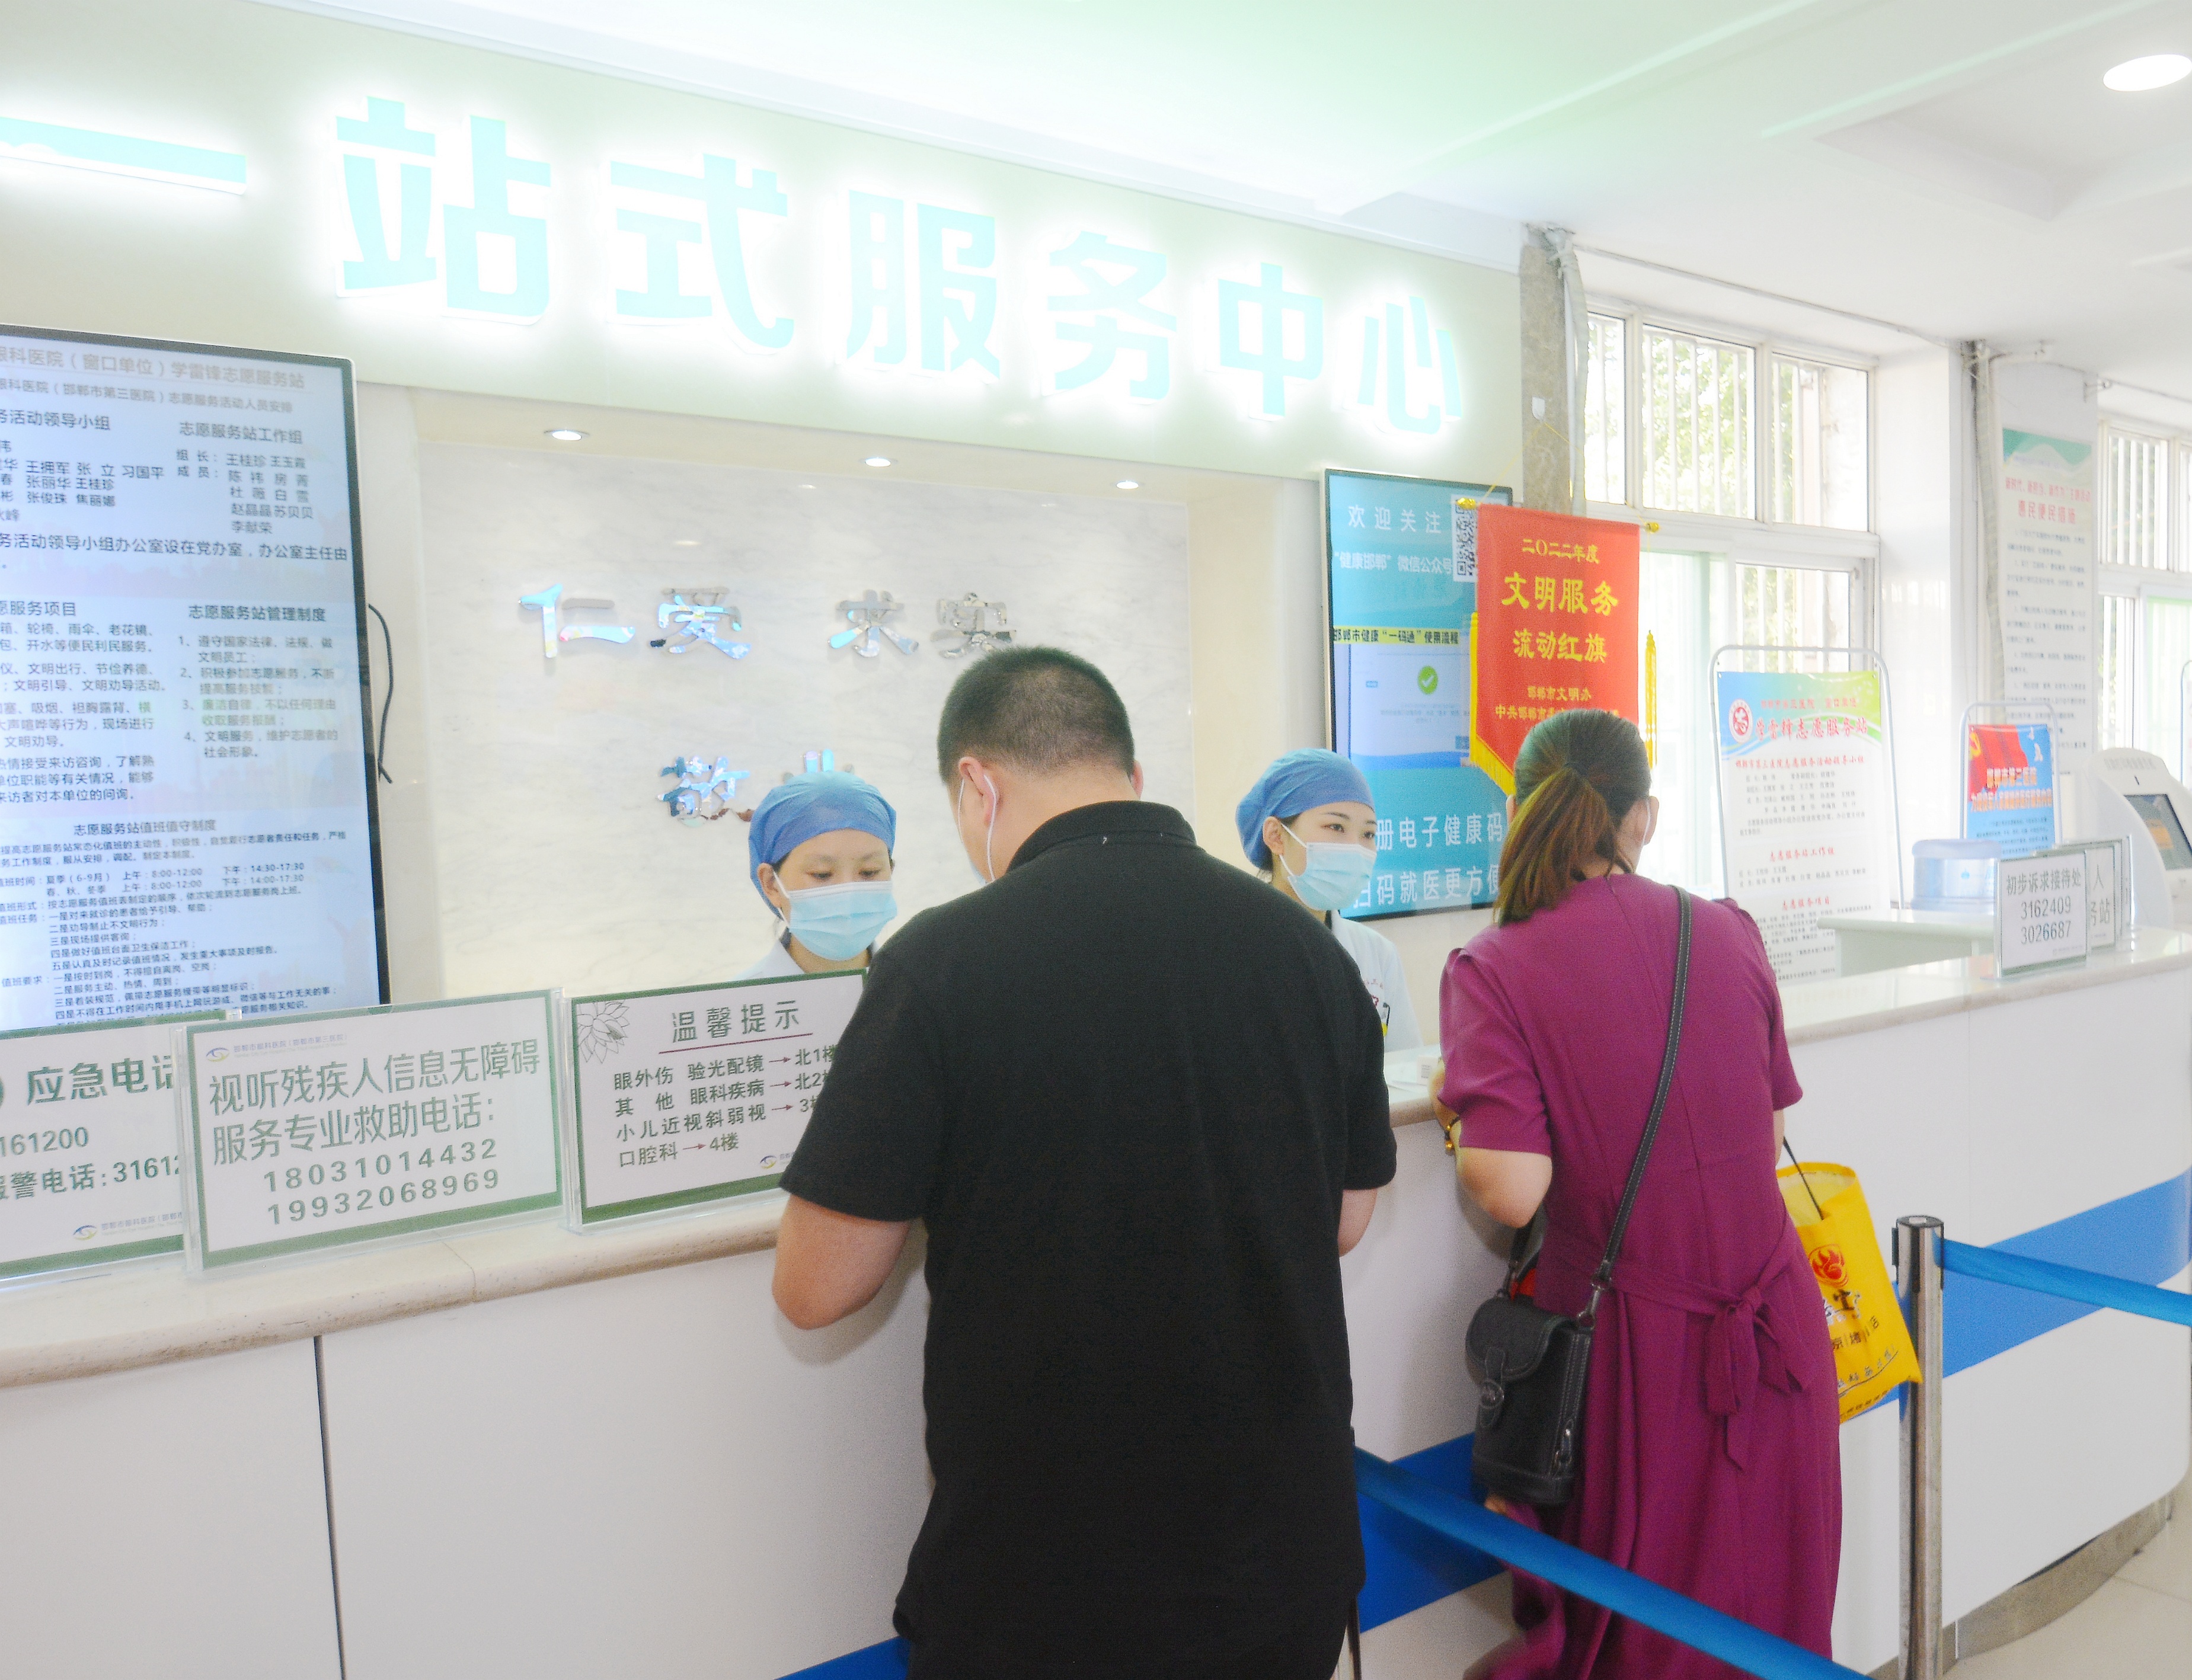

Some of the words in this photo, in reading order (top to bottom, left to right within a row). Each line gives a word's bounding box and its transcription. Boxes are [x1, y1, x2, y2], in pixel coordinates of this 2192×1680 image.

[0, 95, 1463, 436] 一站式服务中心
[0, 458, 18, 471] 华
[1348, 504, 1442, 534] 欢迎关注
[1501, 571, 1619, 616] 文明服务
[1513, 628, 1608, 663] 流动红旗
[1755, 716, 1868, 741] 学雷锋志愿服务站
[2006, 868, 2082, 895] 初步诉求接待处
[2021, 895, 2072, 920] 3162409
[2021, 920, 2071, 945] 3026687
[672, 1000, 800, 1044] 温馨提示
[27, 1055, 174, 1106] 应急电话
[209, 1038, 540, 1116] 视听残疾人信息无障碍
[614, 1067, 673, 1092] 眼外伤
[688, 1054, 765, 1081] 验光配镜
[616, 1093, 675, 1118] 其他
[690, 1079, 765, 1106] 眼科疾病
[616, 1103, 767, 1143] 小儿近视斜弱视
[263, 1138, 497, 1192] 18031014432
[619, 1141, 679, 1168] 口腔科
[709, 1132, 740, 1152] 4楼
[267, 1168, 500, 1225] 19932068969
